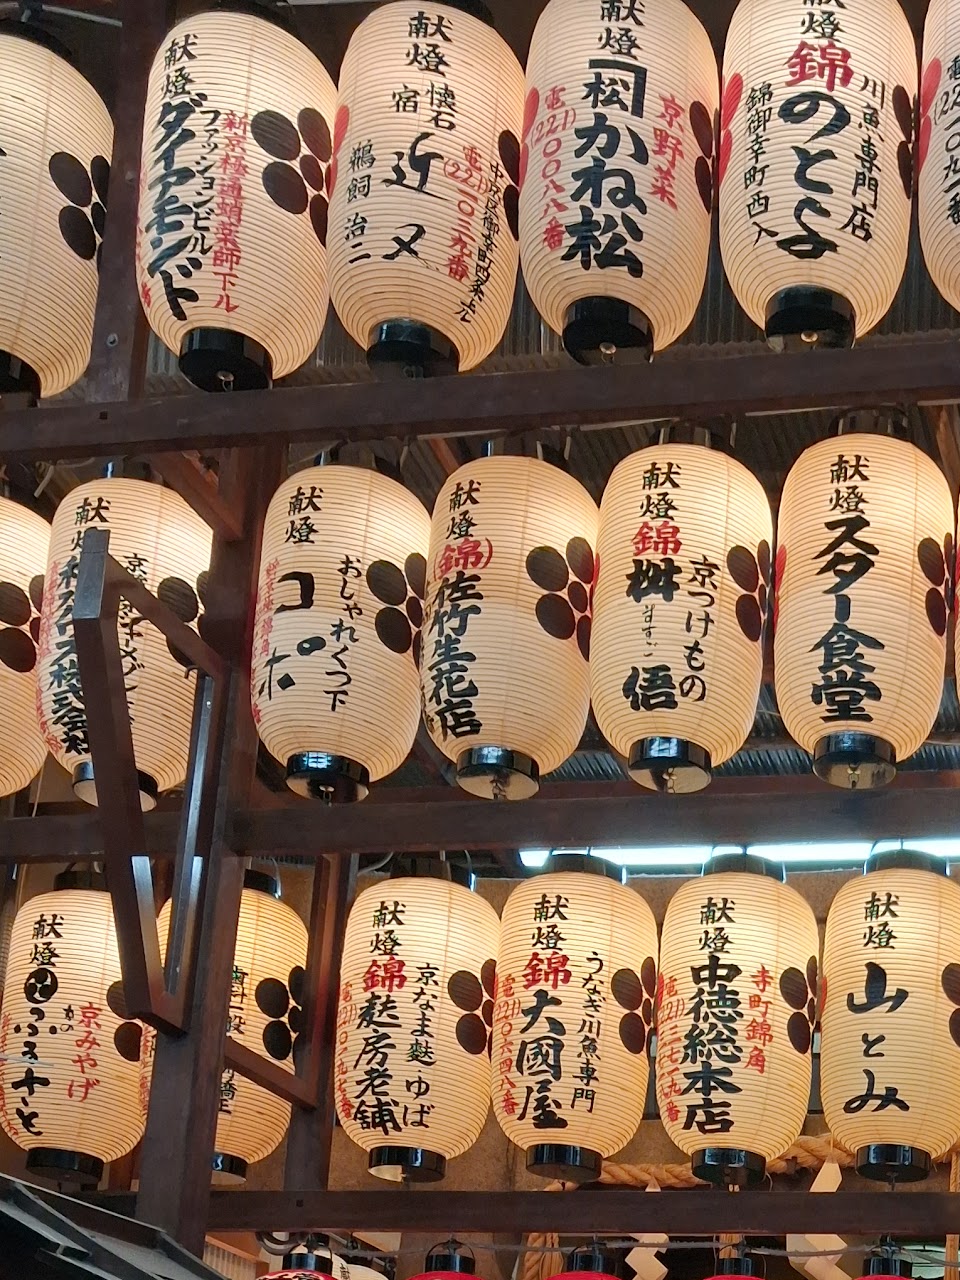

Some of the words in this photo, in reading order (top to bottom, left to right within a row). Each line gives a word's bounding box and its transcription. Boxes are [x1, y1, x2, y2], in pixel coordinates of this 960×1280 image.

[160, 34, 199, 97] 献燈
[406, 12, 453, 76] 献燈
[598, 0, 645, 60] 献燈
[785, 40, 855, 93] 錦
[188, 106, 220, 256] ファッションビル
[382, 131, 448, 266] 近又
[560, 113, 648, 278] かね松
[646, 93, 687, 210] 京野菜
[743, 85, 781, 247] 錦御幸町西入
[776, 90, 852, 260] のとよ
[838, 75, 887, 243] 川魚専門店
[145, 95, 207, 321] ダイアモンド
[211, 109, 250, 313] 新京極通蛸薬師下ル
[285, 486, 324, 546] 献燈
[445, 479, 483, 540] 献燈
[640, 462, 682, 521] 献燈
[828, 454, 870, 515] 献燈
[631, 521, 683, 557] 錦
[322, 554, 364, 712] おしゃれくつ下
[428, 571, 485, 742] 佐竹生花店
[678, 554, 720, 703] 京つけもの
[808, 514, 886, 723] スター食堂
[29, 913, 65, 968] 献燈
[370, 900, 407, 956] 献燈
[521, 951, 572, 991] 錦
[531, 893, 570, 952] 献燈
[698, 897, 737, 954] 献燈
[863, 891, 900, 950] 献燈
[362, 955, 408, 993] 錦
[744, 964, 774, 1074] 寺町錦角
[66, 1002, 103, 1103] 京みやげ
[515, 989, 569, 1130] 大國屋
[680, 954, 744, 1135] 中徳総本店
[843, 961, 910, 1114] 山とみ
